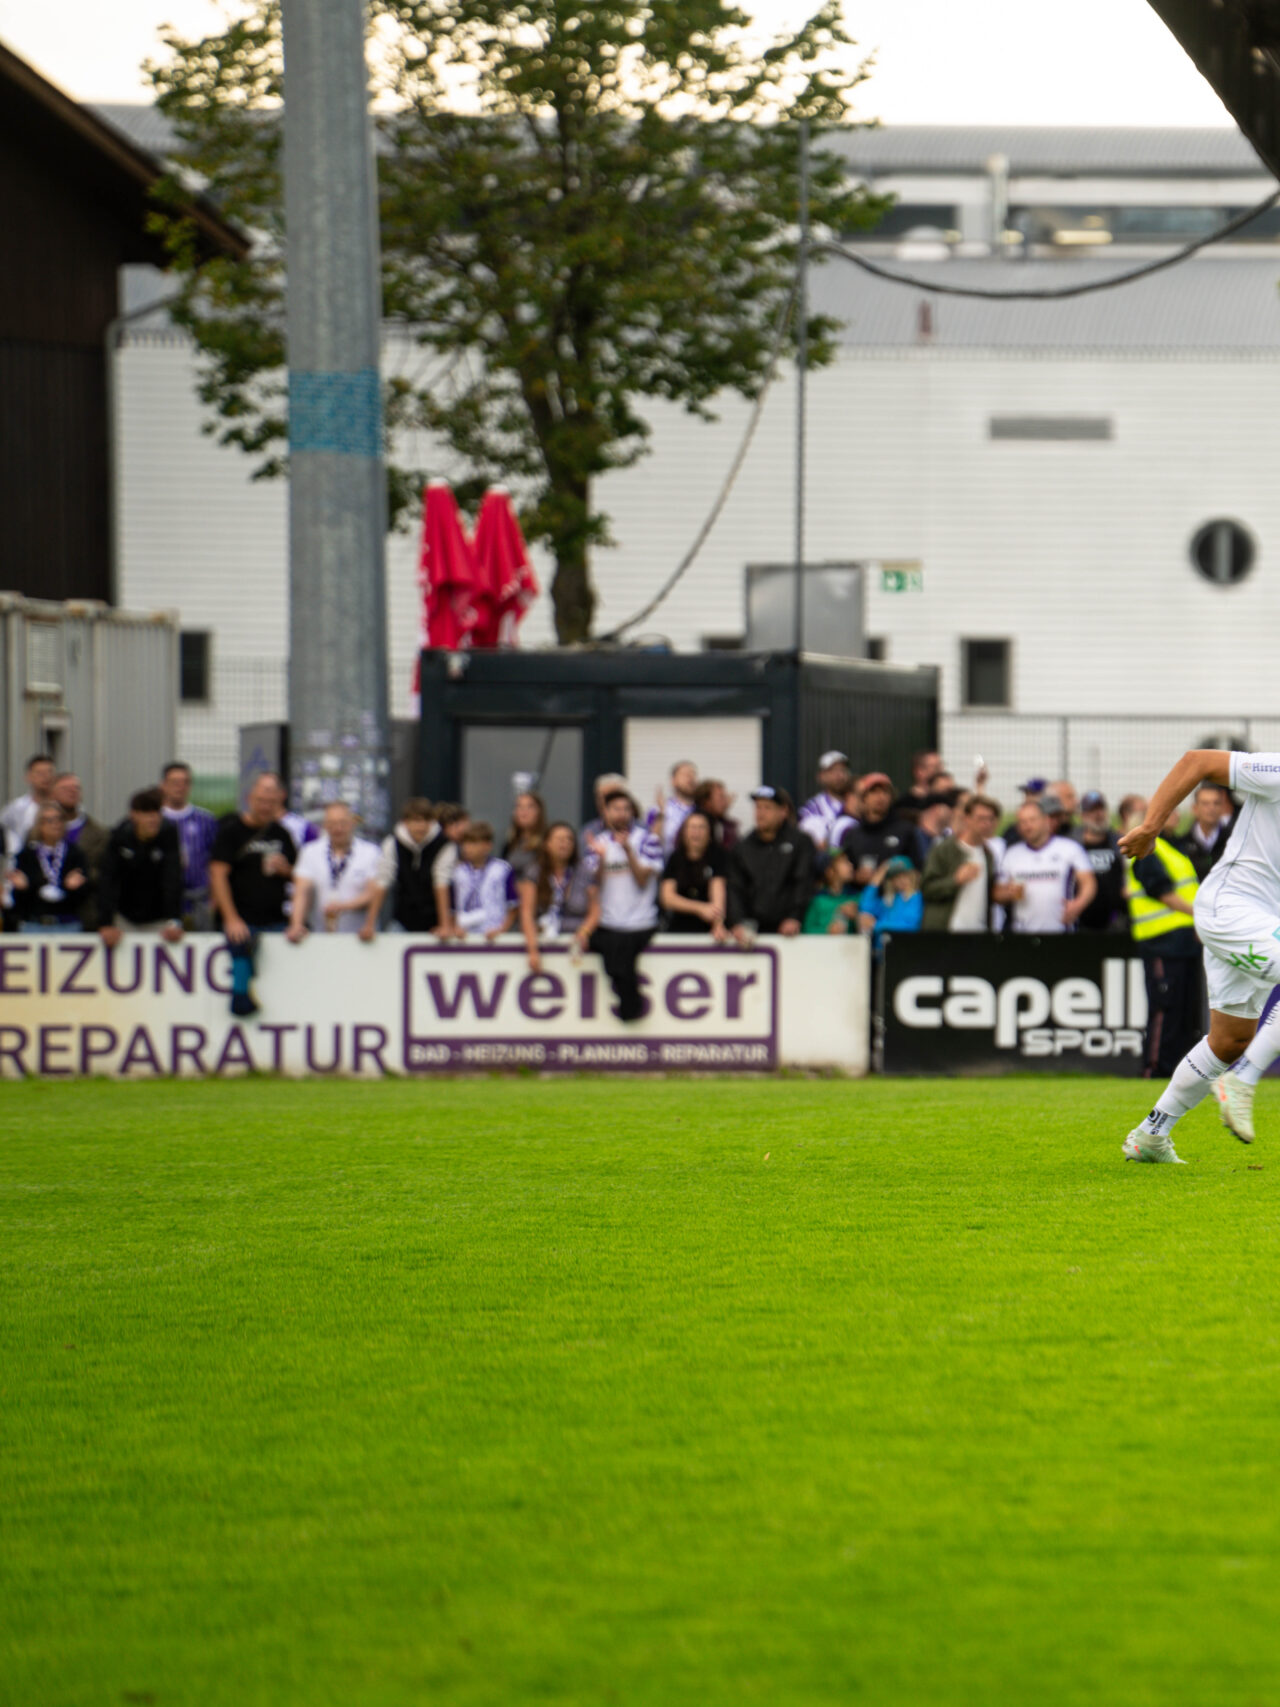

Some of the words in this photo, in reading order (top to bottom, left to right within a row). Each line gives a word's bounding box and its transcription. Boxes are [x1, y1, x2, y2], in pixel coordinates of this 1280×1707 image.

[894, 957, 1148, 1048] capell
[0, 1024, 391, 1076] REPARATUR
[409, 1043, 451, 1065] BAD
[462, 1043, 547, 1064] HEIZUNG
[557, 1043, 649, 1064] PLANUNG
[661, 1043, 769, 1064] REPARATUR
[1021, 1028, 1146, 1057] SPOR
